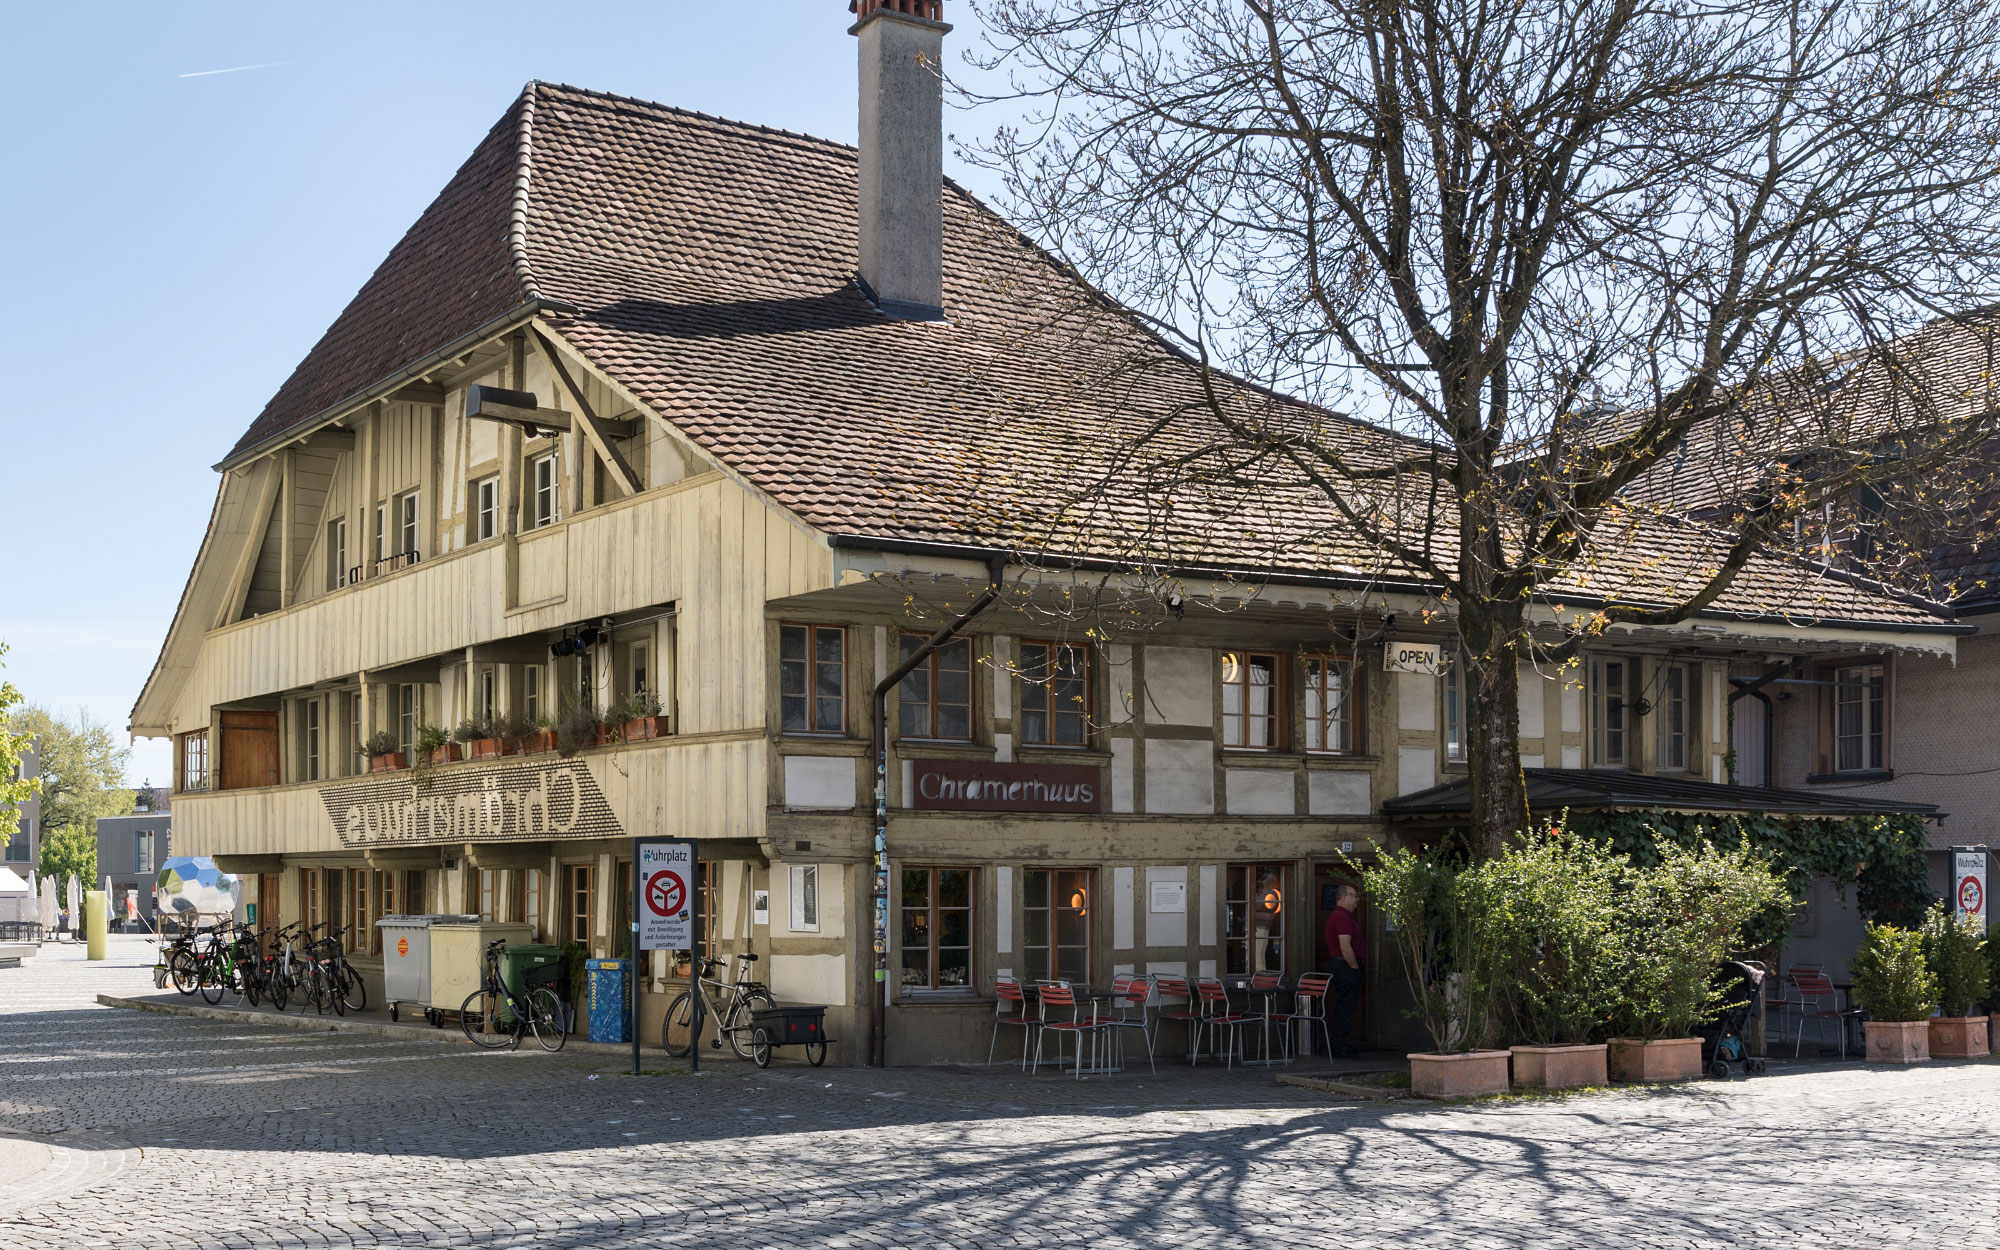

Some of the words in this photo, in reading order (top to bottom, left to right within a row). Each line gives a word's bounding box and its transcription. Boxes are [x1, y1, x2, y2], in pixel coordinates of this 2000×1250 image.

[1385, 642, 1393, 671] OPEN
[1399, 649, 1434, 665] OPEN
[919, 771, 1094, 804] Chrämerhuus
[1344, 843, 1351, 851] 12
[643, 849, 688, 864] uhrplatz
[1957, 856, 1984, 869] Wuhrpaz
